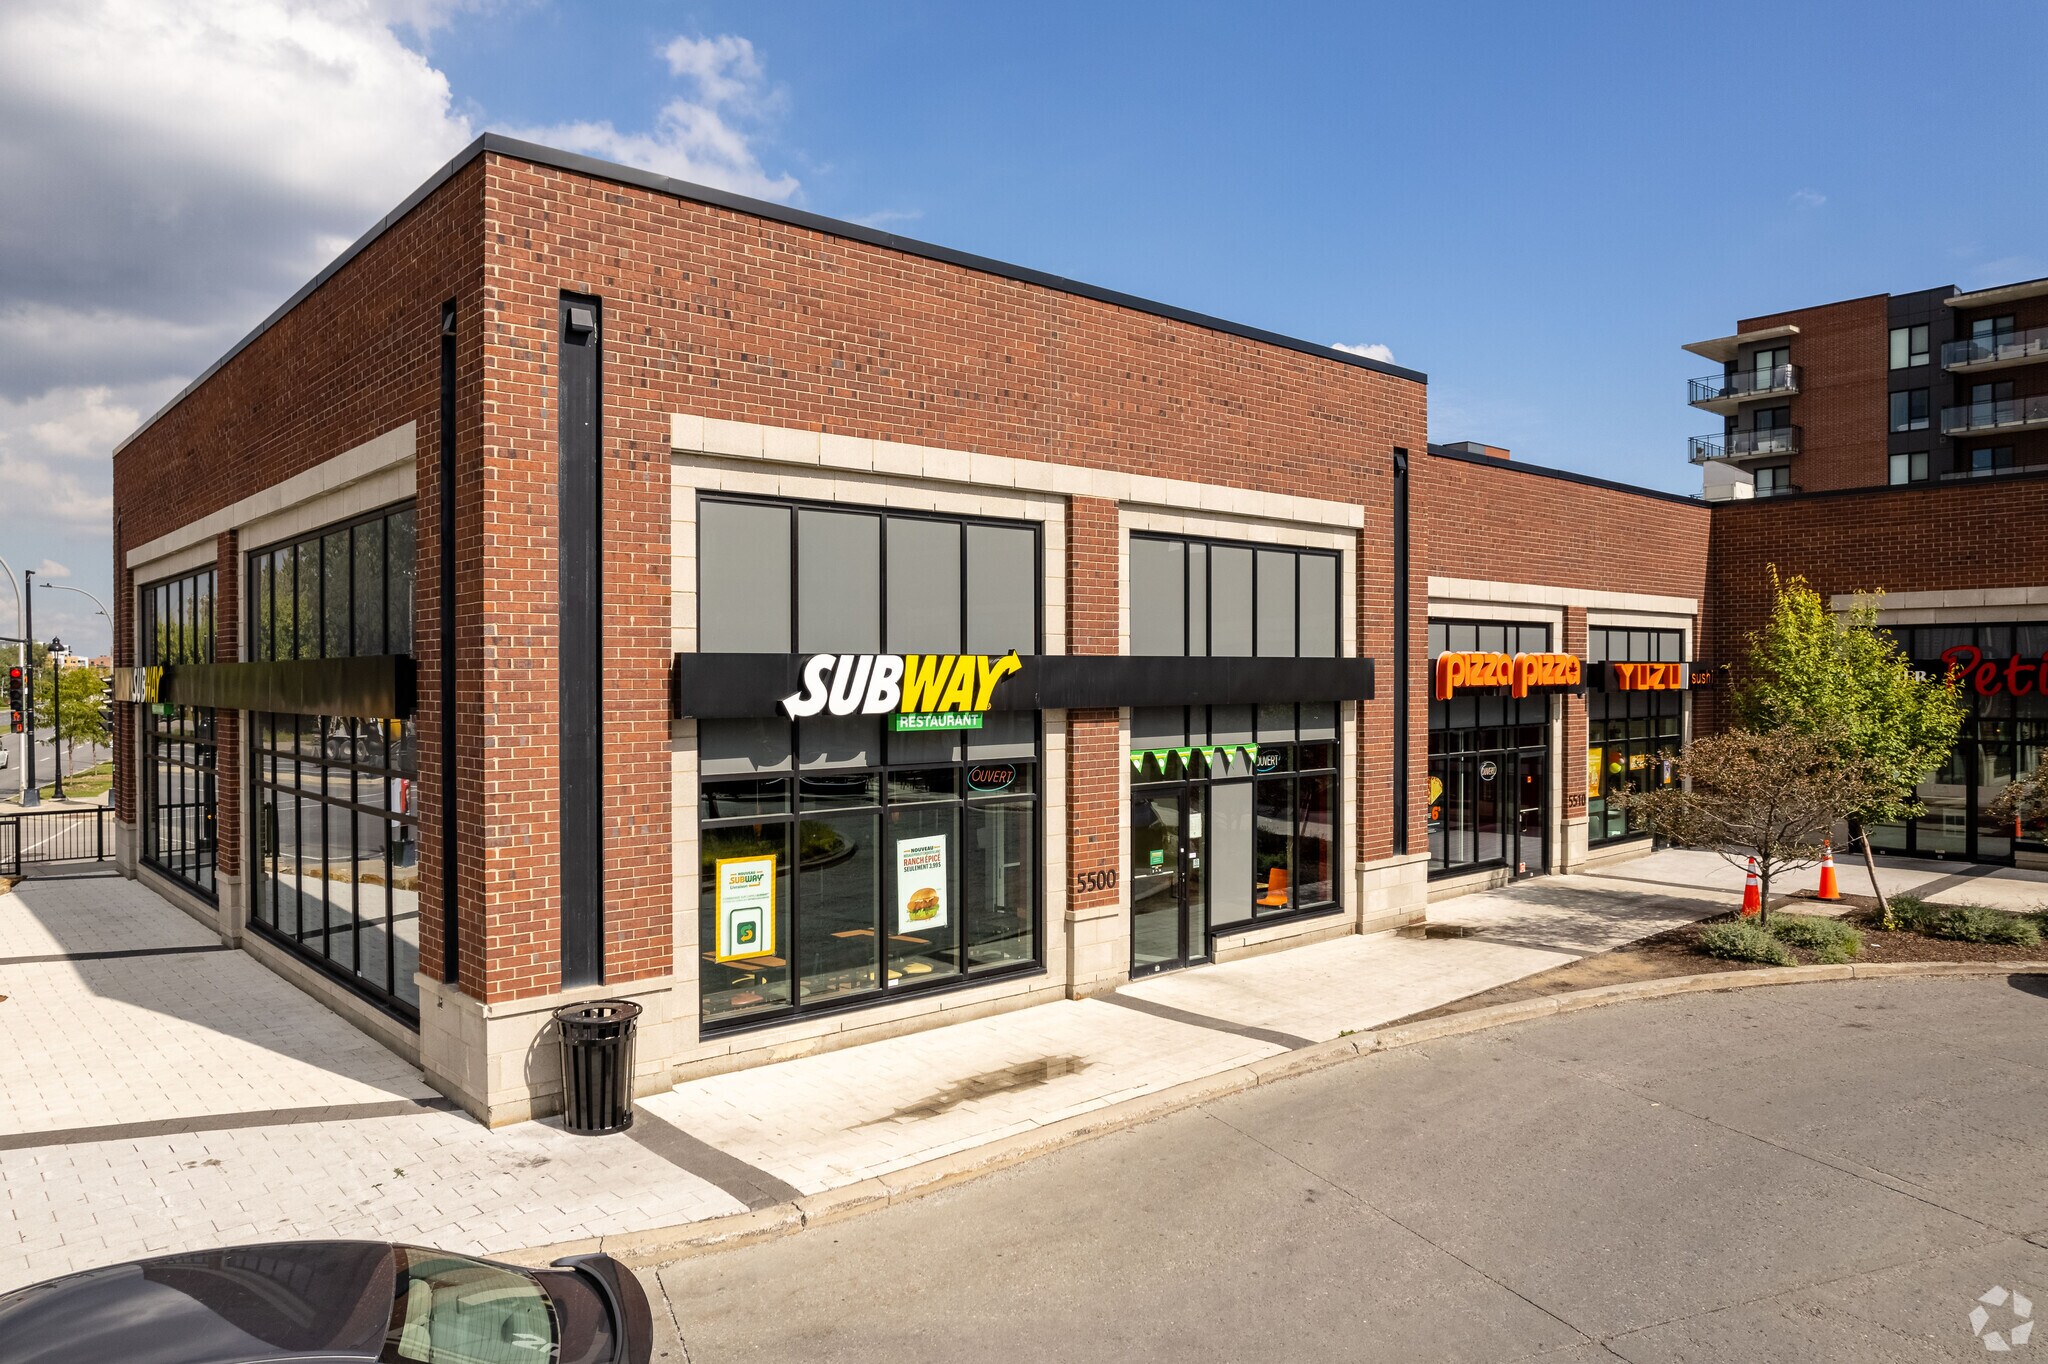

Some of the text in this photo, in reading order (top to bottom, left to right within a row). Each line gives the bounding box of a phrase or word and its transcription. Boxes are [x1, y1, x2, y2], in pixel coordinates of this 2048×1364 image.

[1615, 663, 1681, 690] YUZU
[1691, 669, 1714, 685] sushi
[132, 665, 163, 704] SUBWAY
[783, 650, 1022, 721] SUBWAY
[900, 714, 978, 728] RESTAURANT
[971, 769, 1013, 782] OUVERT
[1568, 794, 1586, 808] 5510
[904, 857, 924, 866] RANCH
[925, 854, 940, 862] ÉPICÉ
[729, 874, 764, 884] SUBWAY
[1077, 869, 1116, 894] 5500
